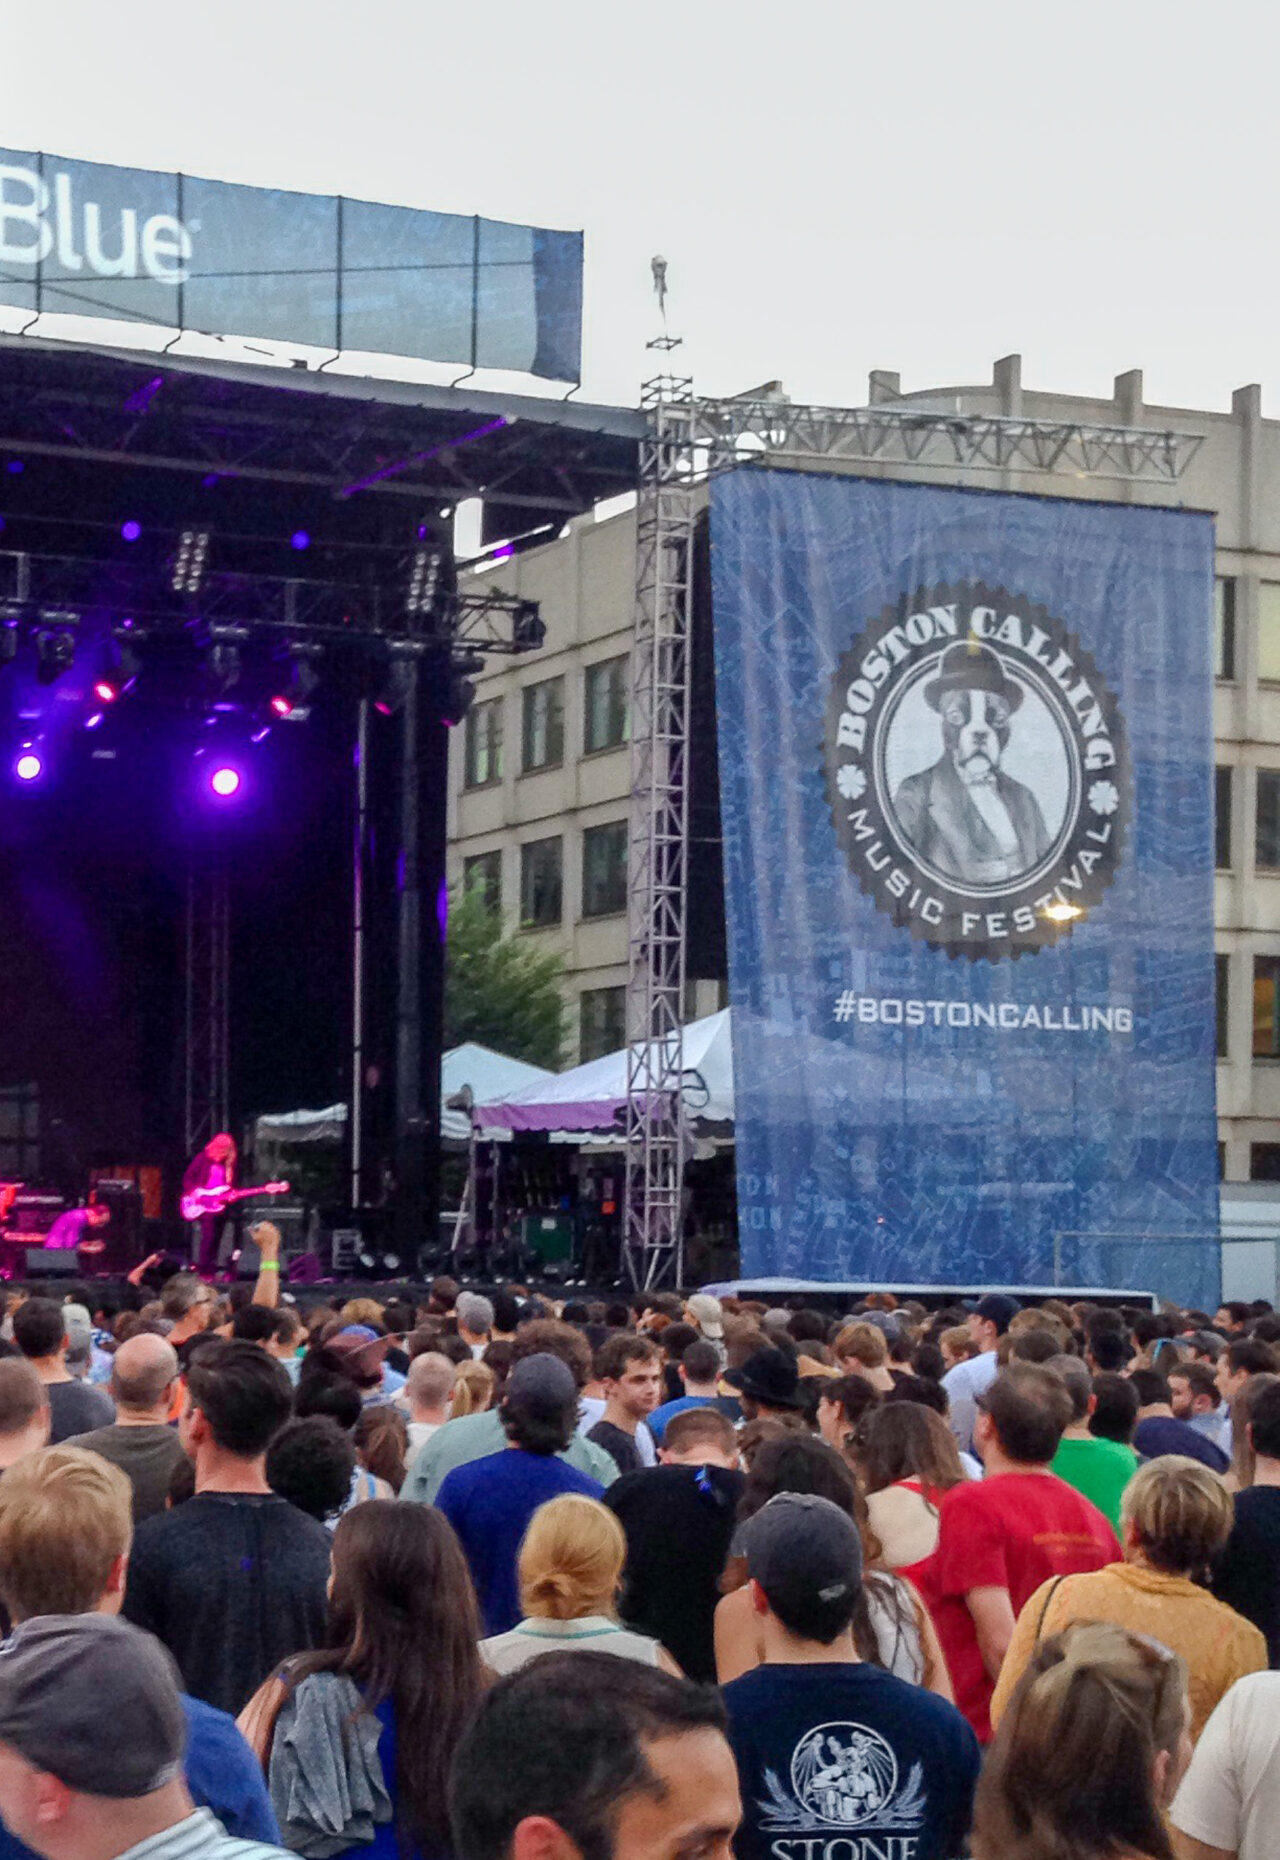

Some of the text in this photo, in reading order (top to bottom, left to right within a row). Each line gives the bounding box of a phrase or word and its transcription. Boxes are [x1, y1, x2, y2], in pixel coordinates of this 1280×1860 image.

[836, 603, 1116, 772] BOSTON CALLING
[846, 808, 1112, 938] MUSIC FESTIVAL
[833, 990, 1134, 1033] #BOSTONCALLING
